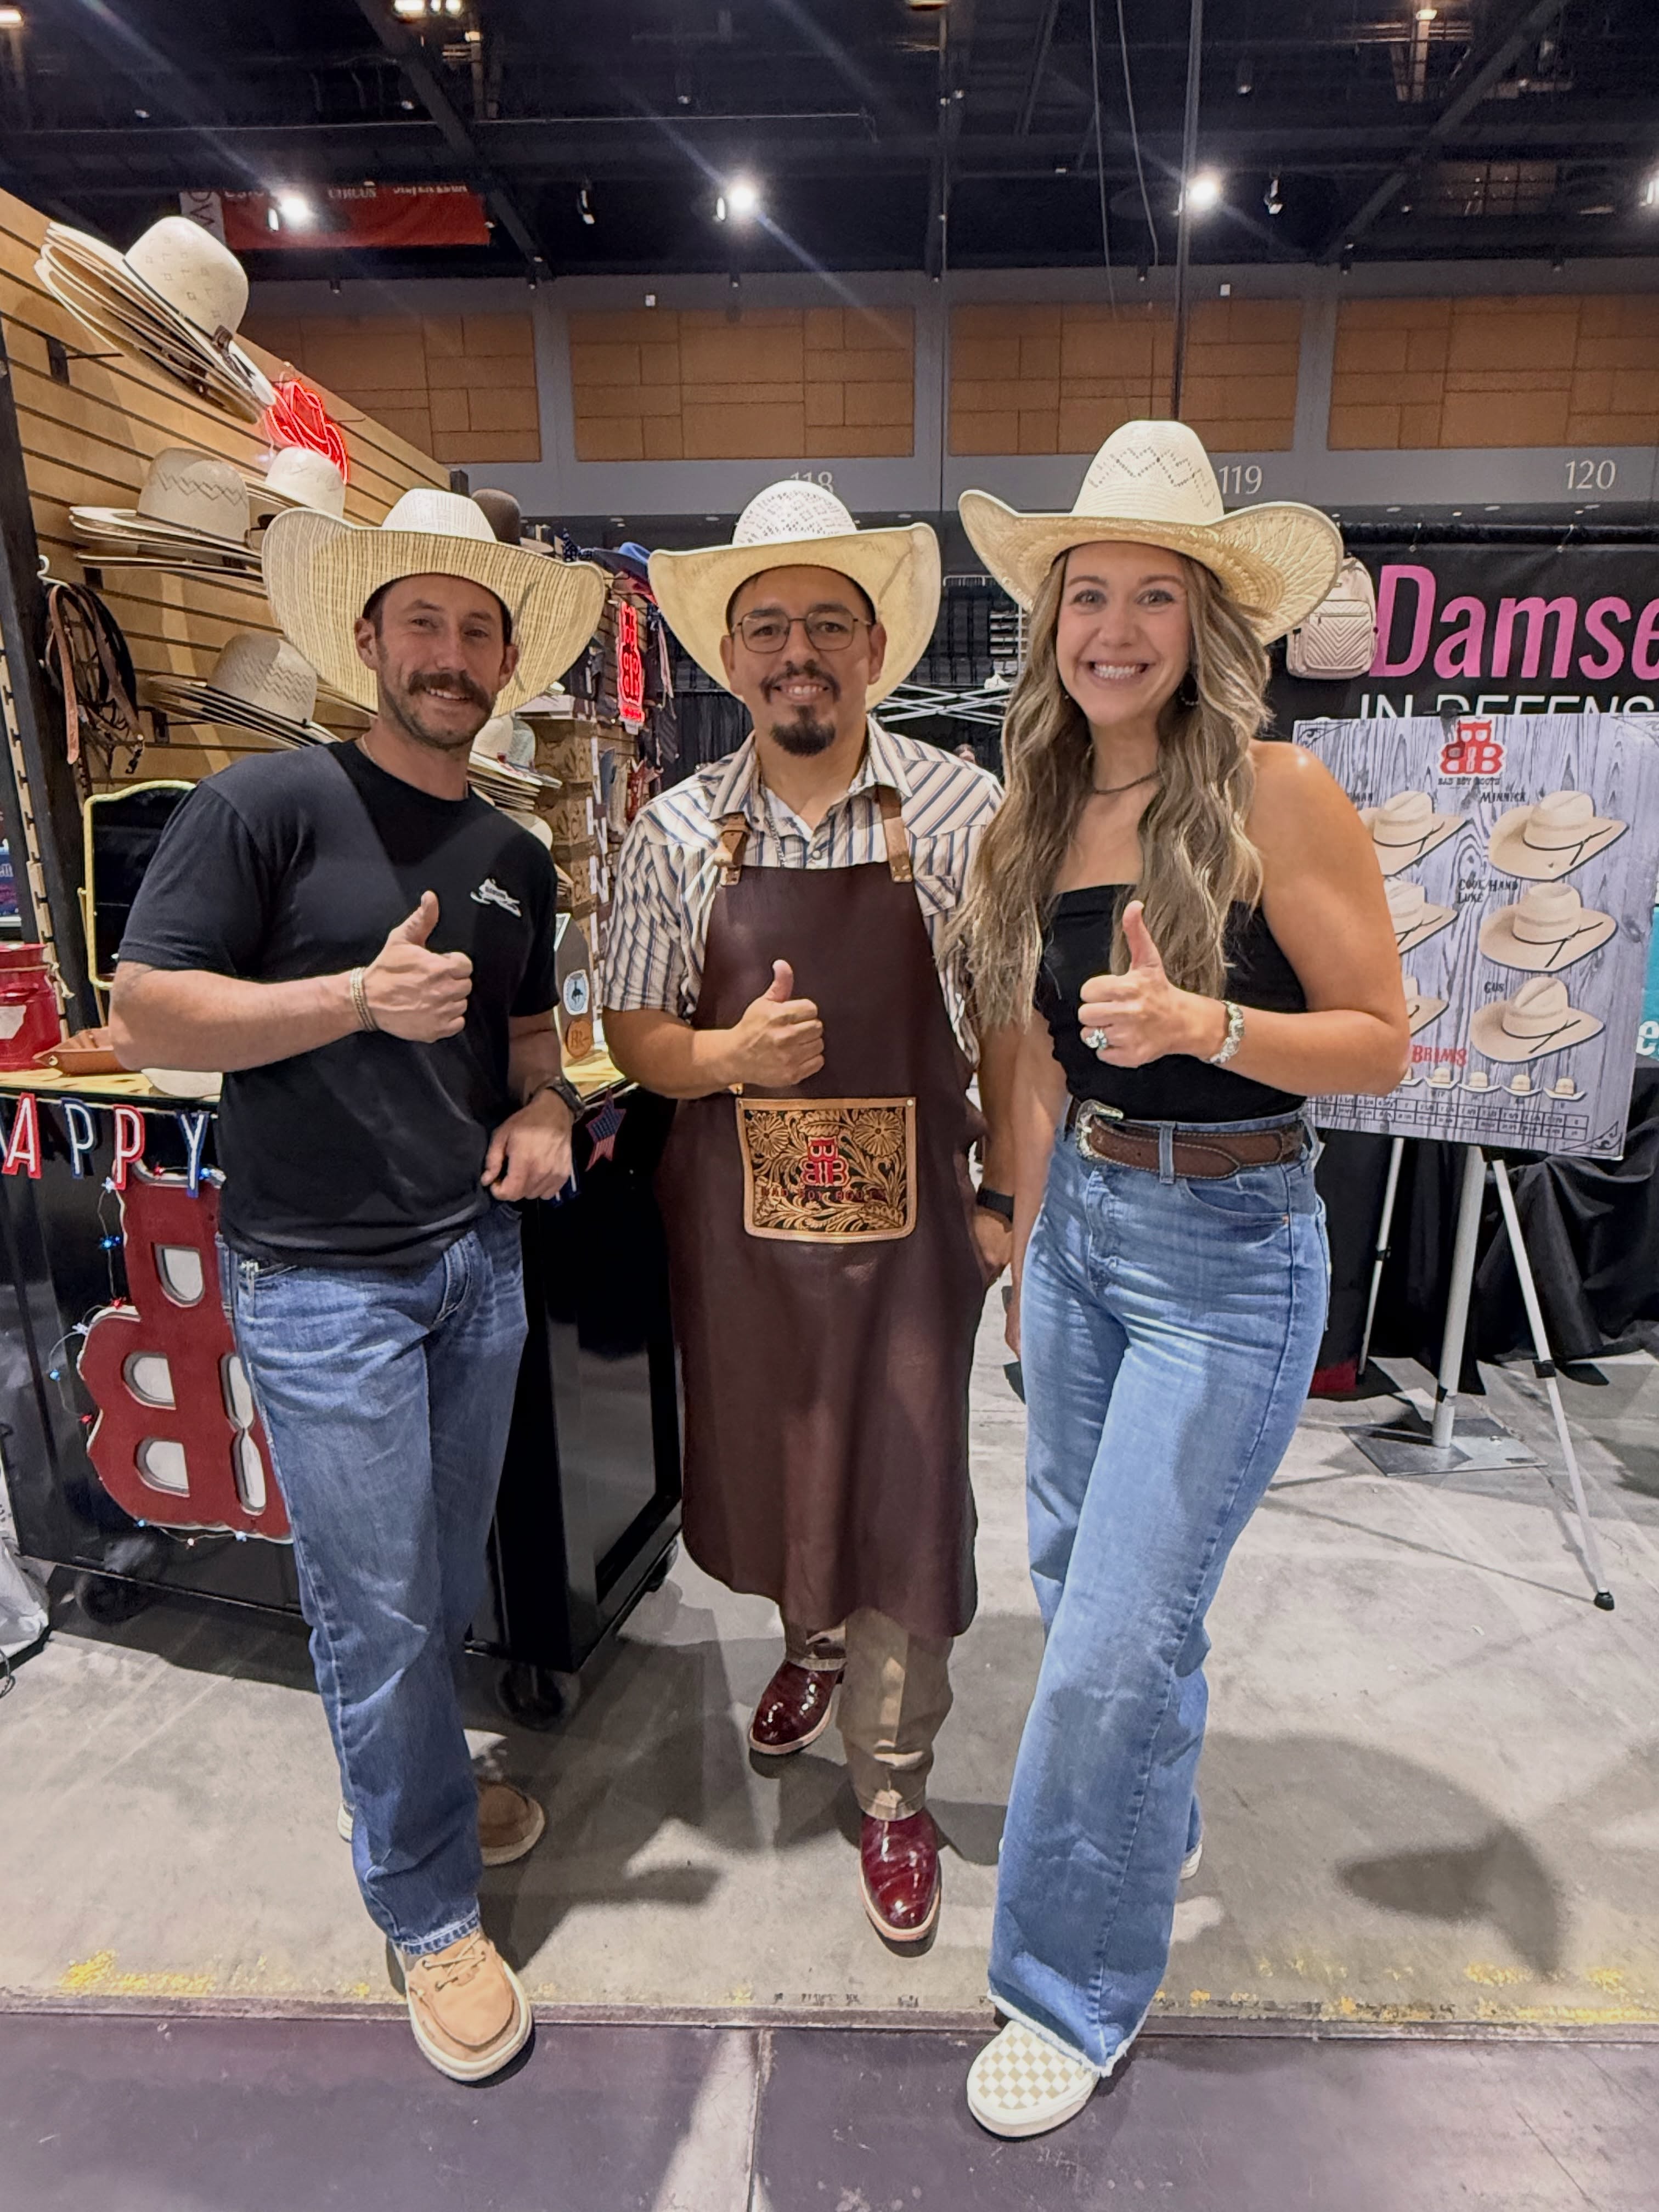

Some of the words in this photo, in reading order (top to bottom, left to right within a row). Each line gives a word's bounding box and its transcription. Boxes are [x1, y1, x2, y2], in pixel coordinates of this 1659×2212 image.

[1218, 465, 1262, 494] 119
[1565, 460, 1616, 490] 120
[1412, 1045, 1467, 1067] BRIMS
[0, 1092, 210, 1198] APPY
